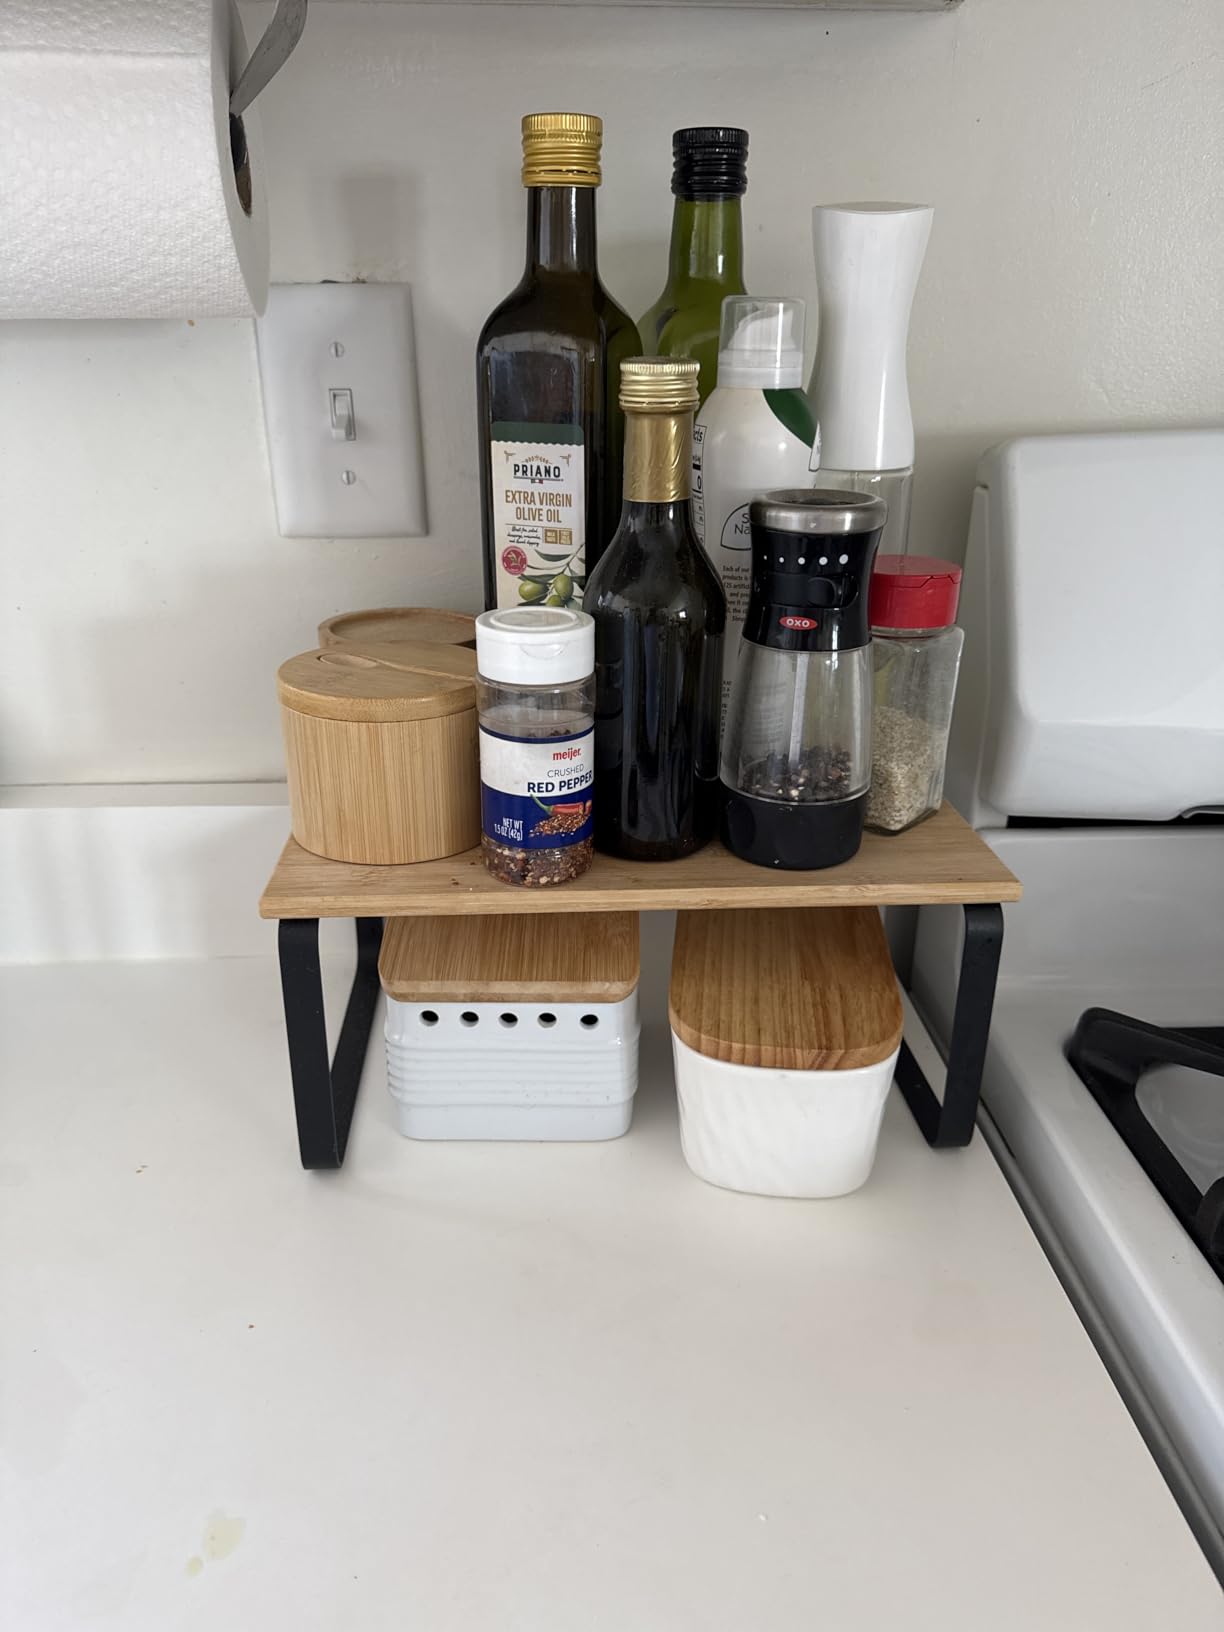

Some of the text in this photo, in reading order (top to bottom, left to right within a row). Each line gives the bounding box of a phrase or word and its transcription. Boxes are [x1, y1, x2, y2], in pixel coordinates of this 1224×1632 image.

[513, 463, 561, 478] PRIANO
[505, 489, 572, 508] EXTRA VIRGIN
[515, 506, 562, 523] OLIVE OIL
[787, 618, 810, 628] OXO
[547, 764, 584, 778] CRUSHED
[527, 770, 593, 793] RED PEPPER
[502, 817, 523, 830] NET WT
[501, 826, 508, 834] OZ
[508, 828, 523, 841] (42g)
